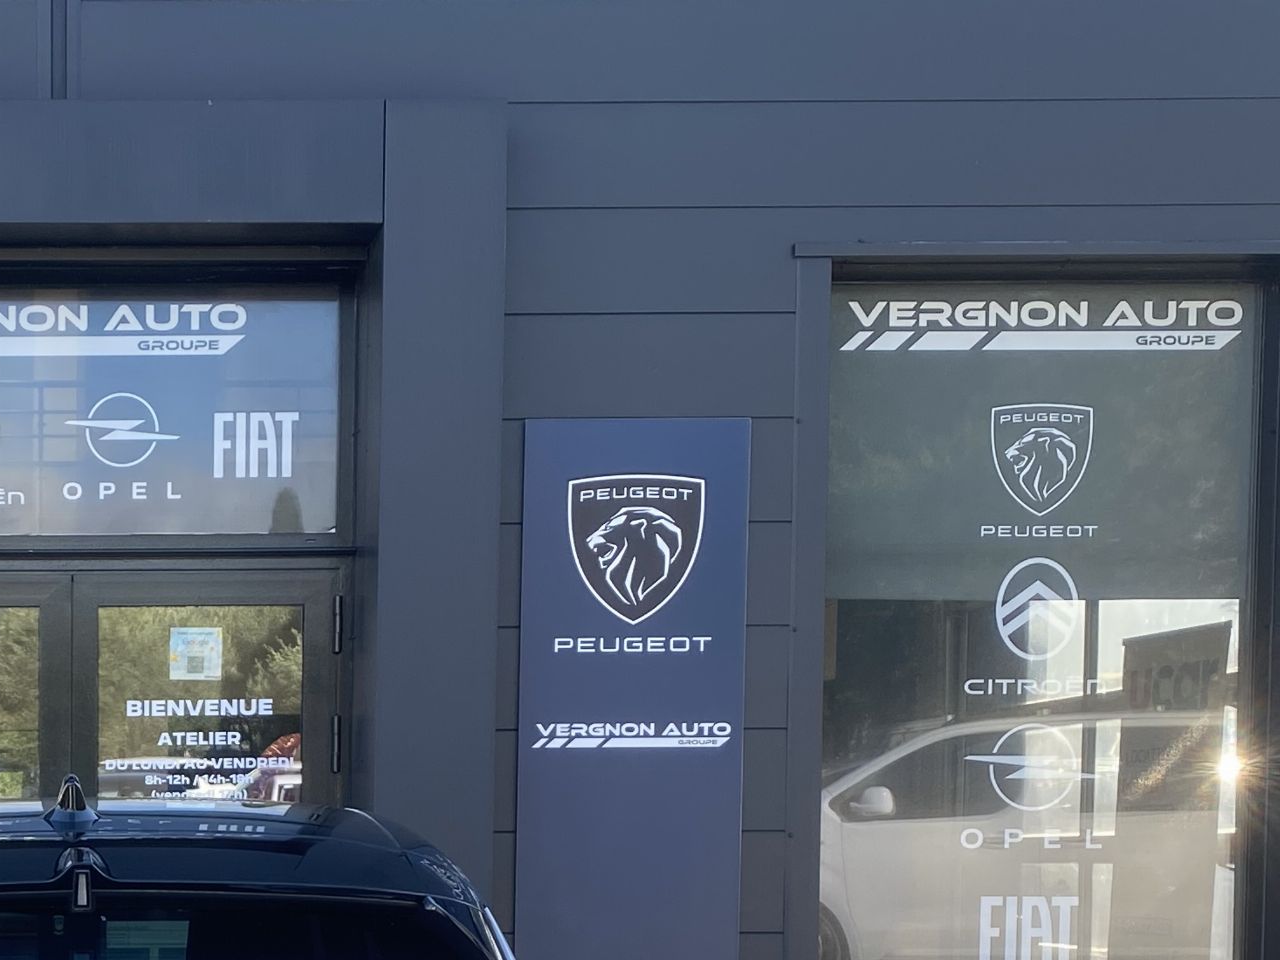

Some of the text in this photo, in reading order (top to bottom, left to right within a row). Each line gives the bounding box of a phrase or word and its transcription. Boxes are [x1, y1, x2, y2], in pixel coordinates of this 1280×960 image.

[102, 303, 248, 332] AUTO
[848, 300, 1244, 328] VERGNON AUTO
[137, 339, 221, 352] GROUPE
[1134, 335, 1217, 346] GROUPE
[999, 412, 1085, 425] PEUGEOT
[213, 412, 300, 479] FIAT
[62, 481, 183, 501] OPEL
[578, 486, 694, 502] PEUGEOT
[980, 525, 1099, 538] PEUGEOT
[553, 636, 713, 653] PEUGEOT
[126, 698, 274, 718] BIENVENUE
[535, 722, 733, 737] VERGNON AUTO
[157, 731, 242, 747] ATELIER
[211, 756, 295, 770] VENDREDI
[144, 774, 191, 786] 8h-12h
[959, 827, 1103, 850] OPEL
